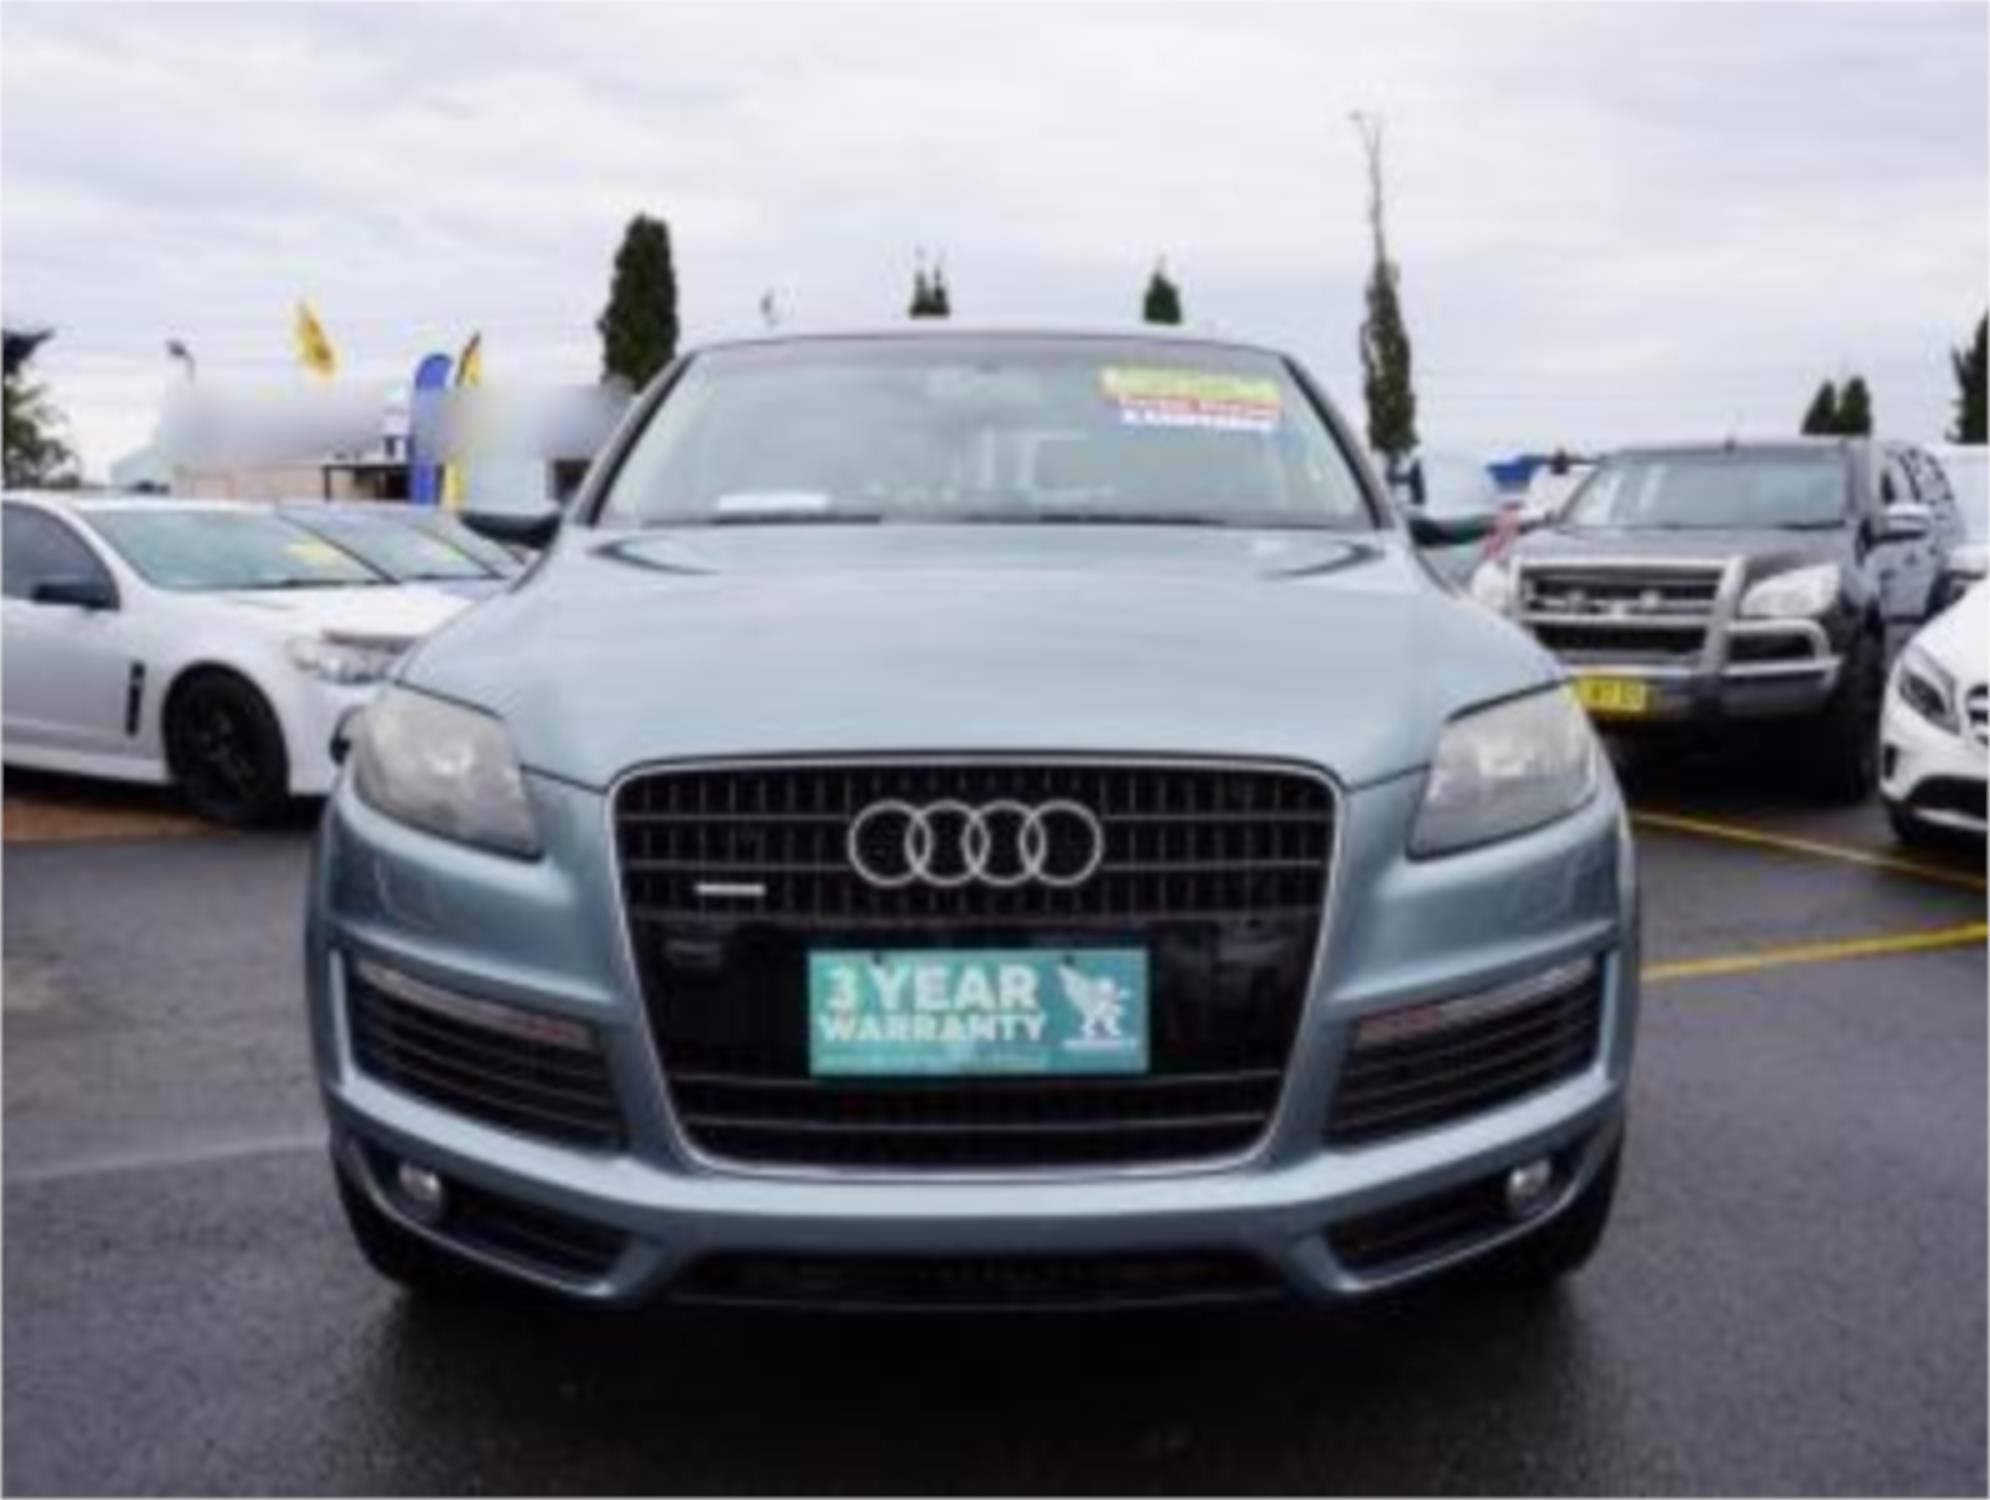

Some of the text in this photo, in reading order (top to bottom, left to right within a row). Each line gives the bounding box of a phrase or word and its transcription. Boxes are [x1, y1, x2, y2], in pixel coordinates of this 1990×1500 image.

[827, 963, 1039, 1011] 3 YEAR
[820, 1013, 1046, 1042] WARRANTY
